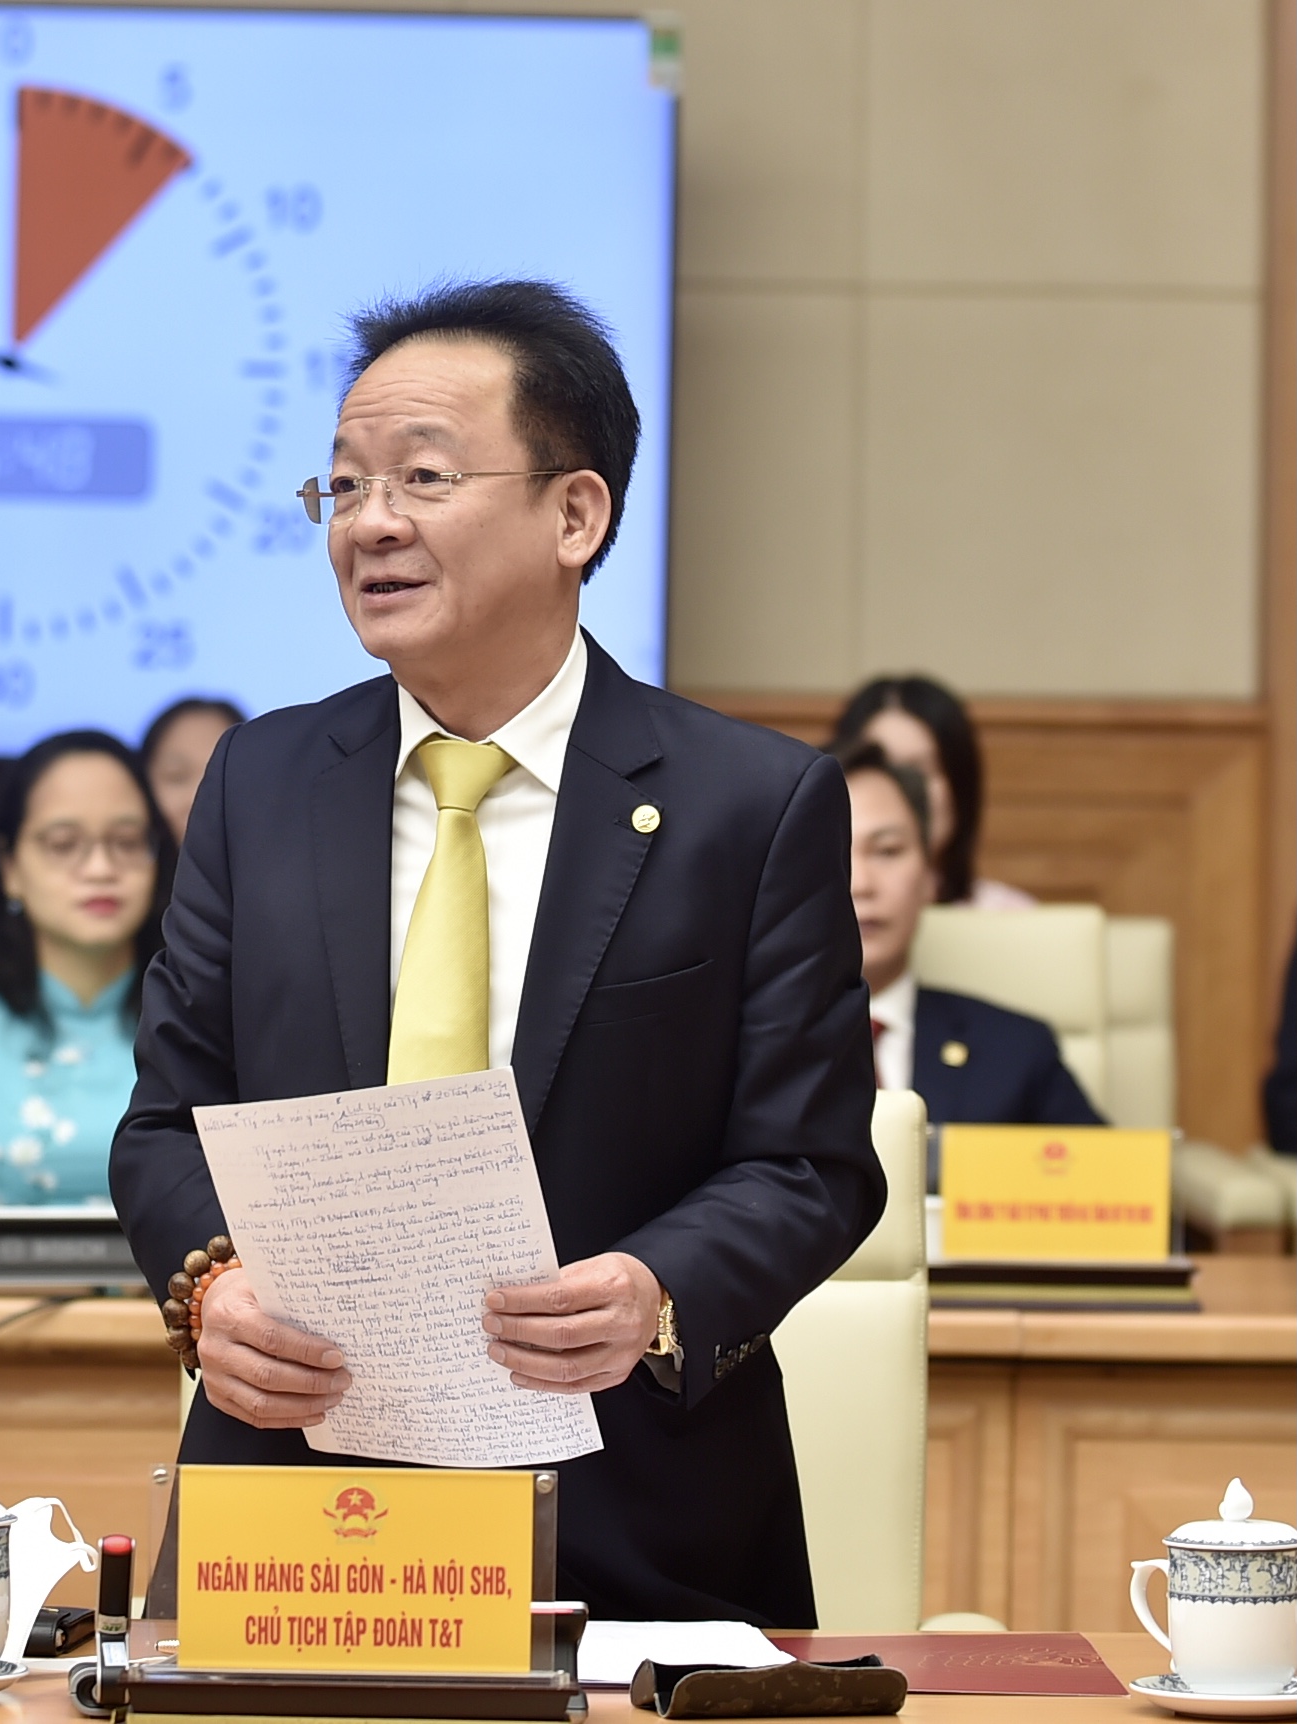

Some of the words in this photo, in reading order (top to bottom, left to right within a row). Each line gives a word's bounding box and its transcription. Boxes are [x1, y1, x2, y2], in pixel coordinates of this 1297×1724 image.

[1, 18, 33, 64] 0
[159, 62, 192, 112] 5
[265, 183, 323, 234] 10
[253, 504, 315, 555] 20
[132, 618, 194, 671] 25
[197, 1556, 247, 1592] NGÂN
[255, 1556, 303, 1593] HÀNG
[310, 1557, 340, 1593] SÀI
[347, 1557, 383, 1594] GÒN
[403, 1559, 426, 1595] HÀ
[433, 1559, 464, 1602] NỘI
[470, 1566, 512, 1599] SHB,
[245, 1606, 281, 1646] CHỦ
[287, 1616, 327, 1653] TỊCH
[333, 1611, 367, 1653] TẬP
[373, 1612, 422, 1648] ĐOÀN
[429, 1618, 464, 1648] T&T
